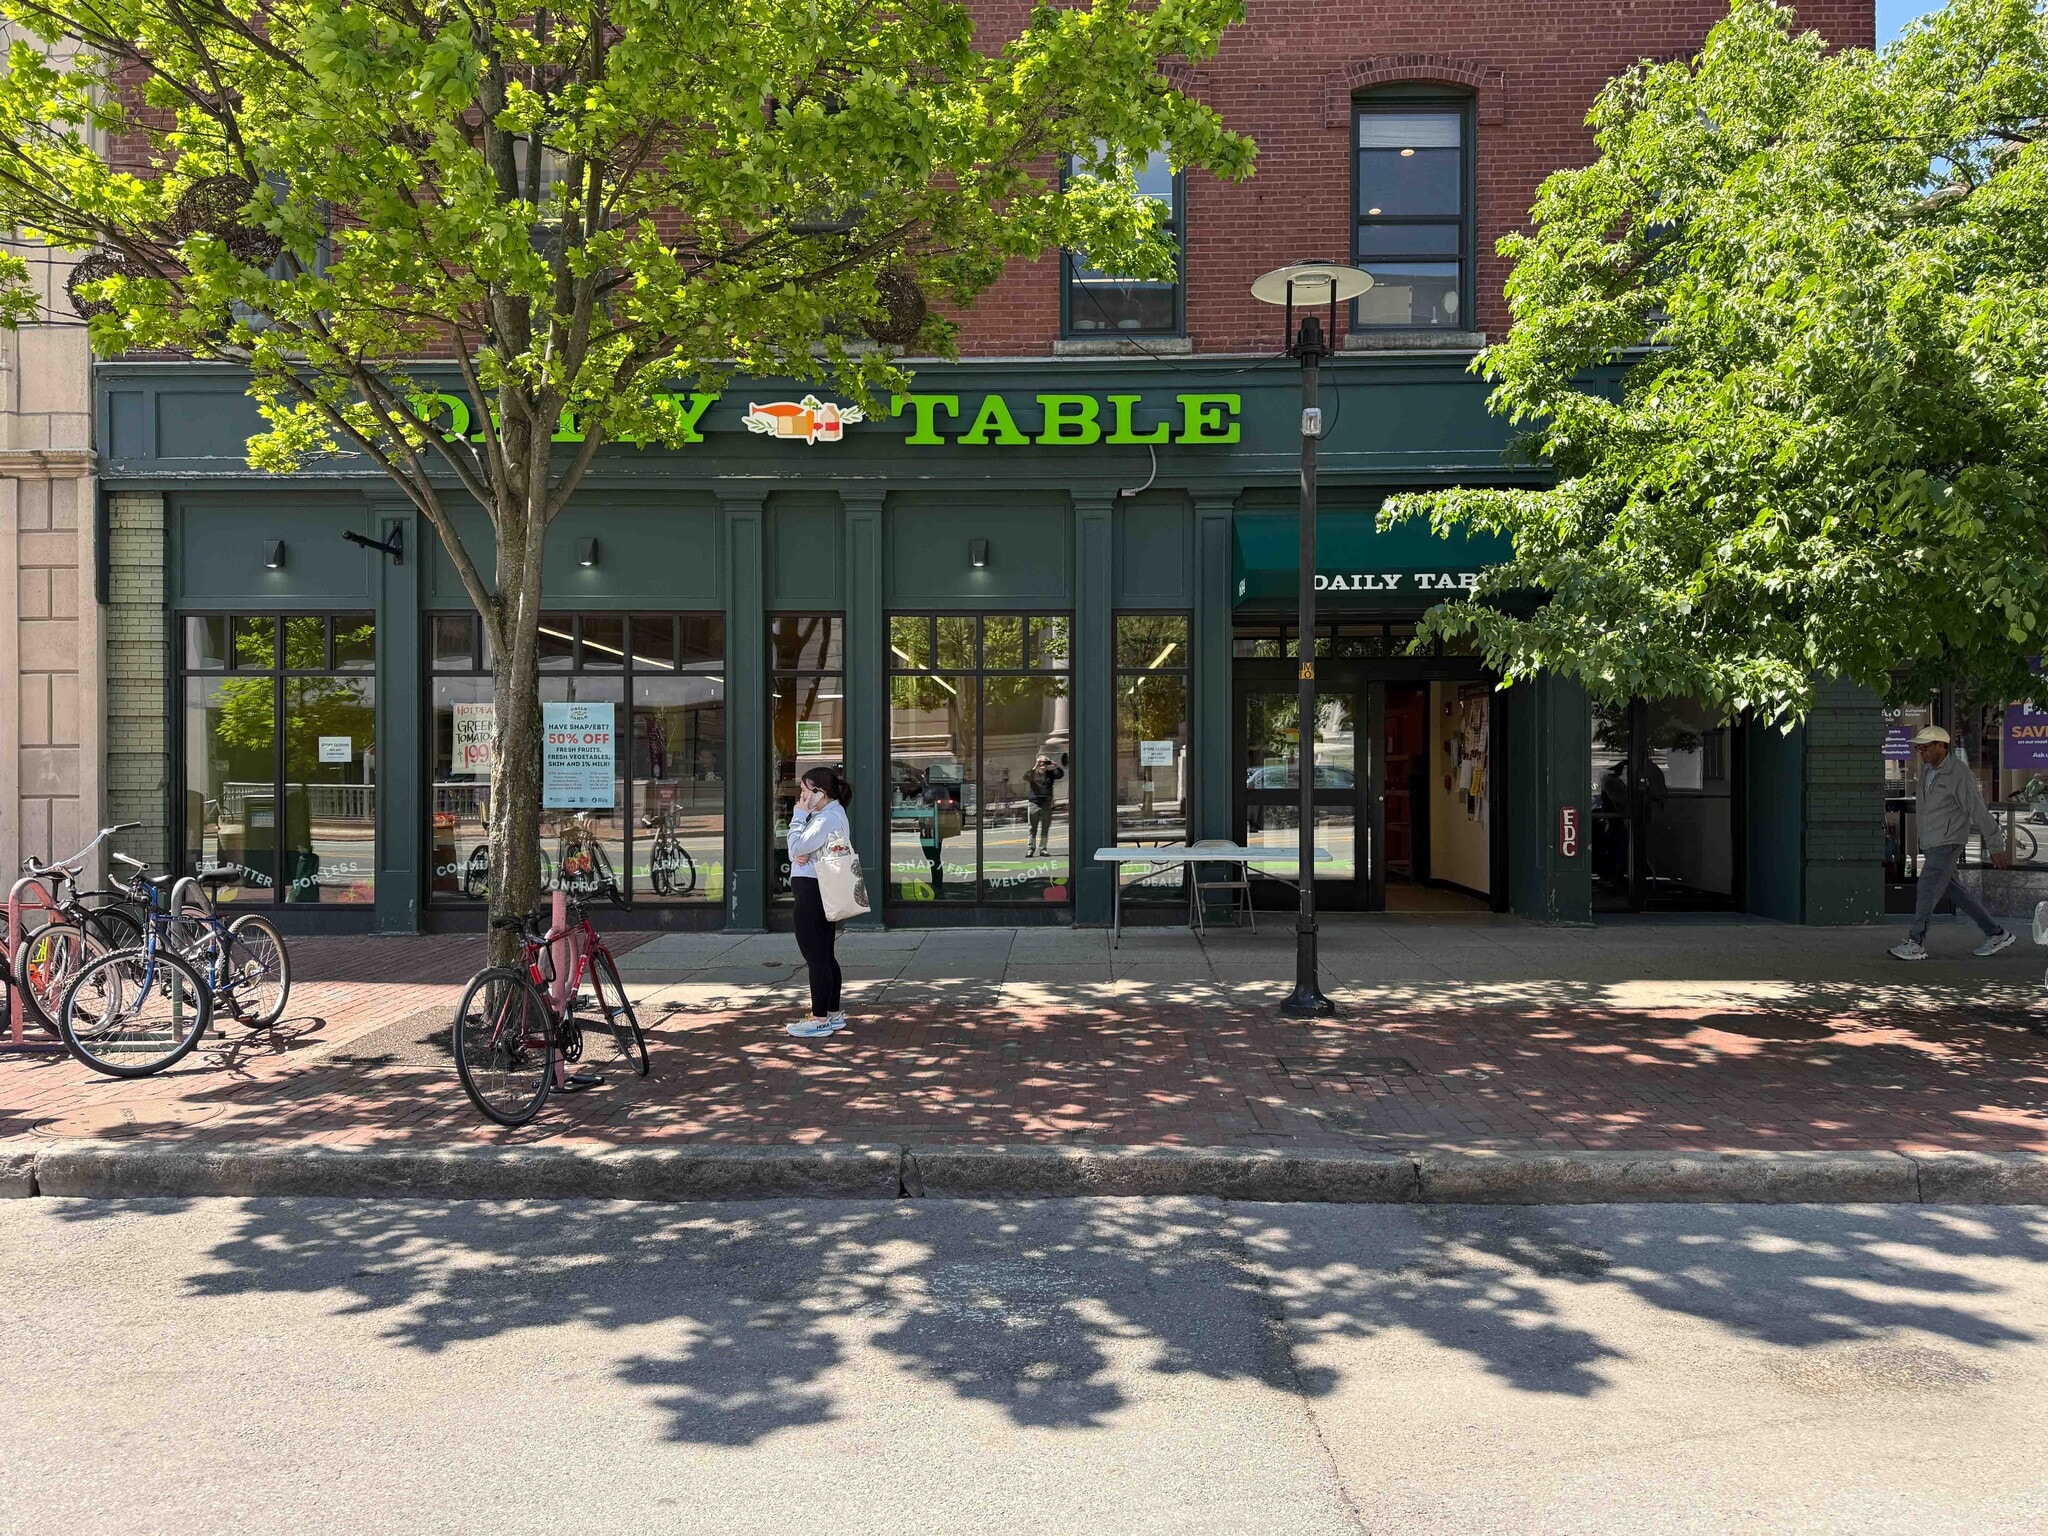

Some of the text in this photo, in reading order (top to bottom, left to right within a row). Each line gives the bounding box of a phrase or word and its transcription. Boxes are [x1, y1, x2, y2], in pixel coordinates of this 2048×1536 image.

[891, 394, 1241, 445] TABLE
[1315, 573, 1519, 591] DAILY TAB
[475, 706, 493, 715] DEA
[548, 733, 609, 744] 50% OFF
[2011, 725, 2048, 738] SAV
[1563, 809, 1576, 857] EDC
[195, 860, 273, 887] EAT BETTER
[292, 861, 358, 889] FOR LESS
[436, 860, 489, 877] COMMU
[989, 860, 1058, 888] WELCOME
[1142, 877, 1183, 887] DEALS
